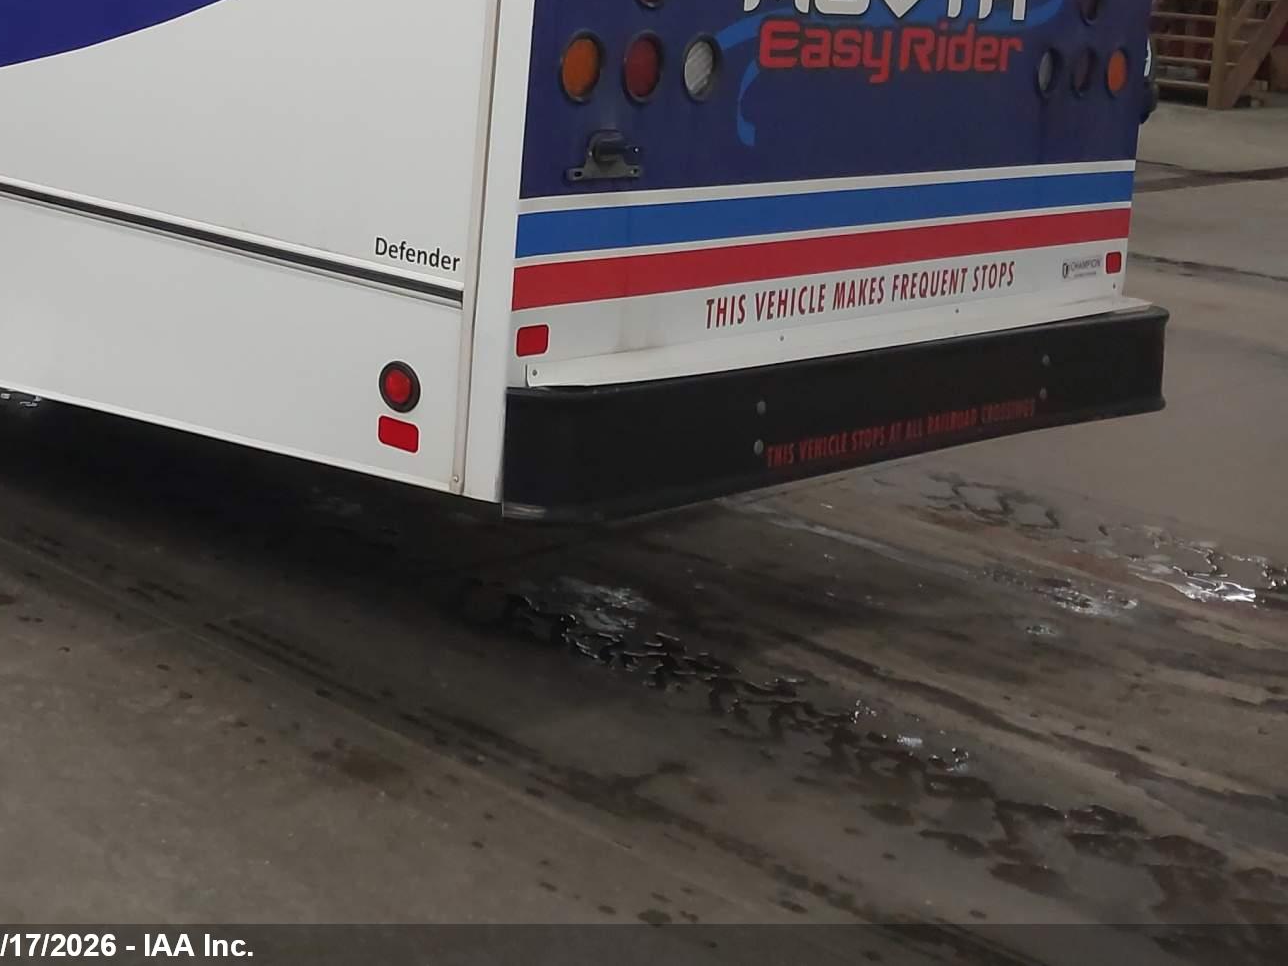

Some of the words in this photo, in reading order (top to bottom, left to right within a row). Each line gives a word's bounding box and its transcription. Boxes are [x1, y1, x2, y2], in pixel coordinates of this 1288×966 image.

[758, 19, 893, 84] Easy
[899, 21, 1023, 74] Rider
[375, 237, 461, 272] Defender
[705, 294, 746, 330] THIS
[755, 284, 825, 322] VEHICLE
[832, 276, 885, 311] MAKES
[891, 267, 969, 302] FREQUENT
[972, 260, 1015, 293] STOPS
[767, 442, 795, 468] THIS
[800, 432, 847, 462] VEHICLE
[851, 425, 885, 452] STOPS
[888, 421, 903, 443] AT
[906, 417, 923, 440] ALL
[927, 408, 978, 434] RAILROAD
[981, 398, 1036, 424] CROSSINGS
